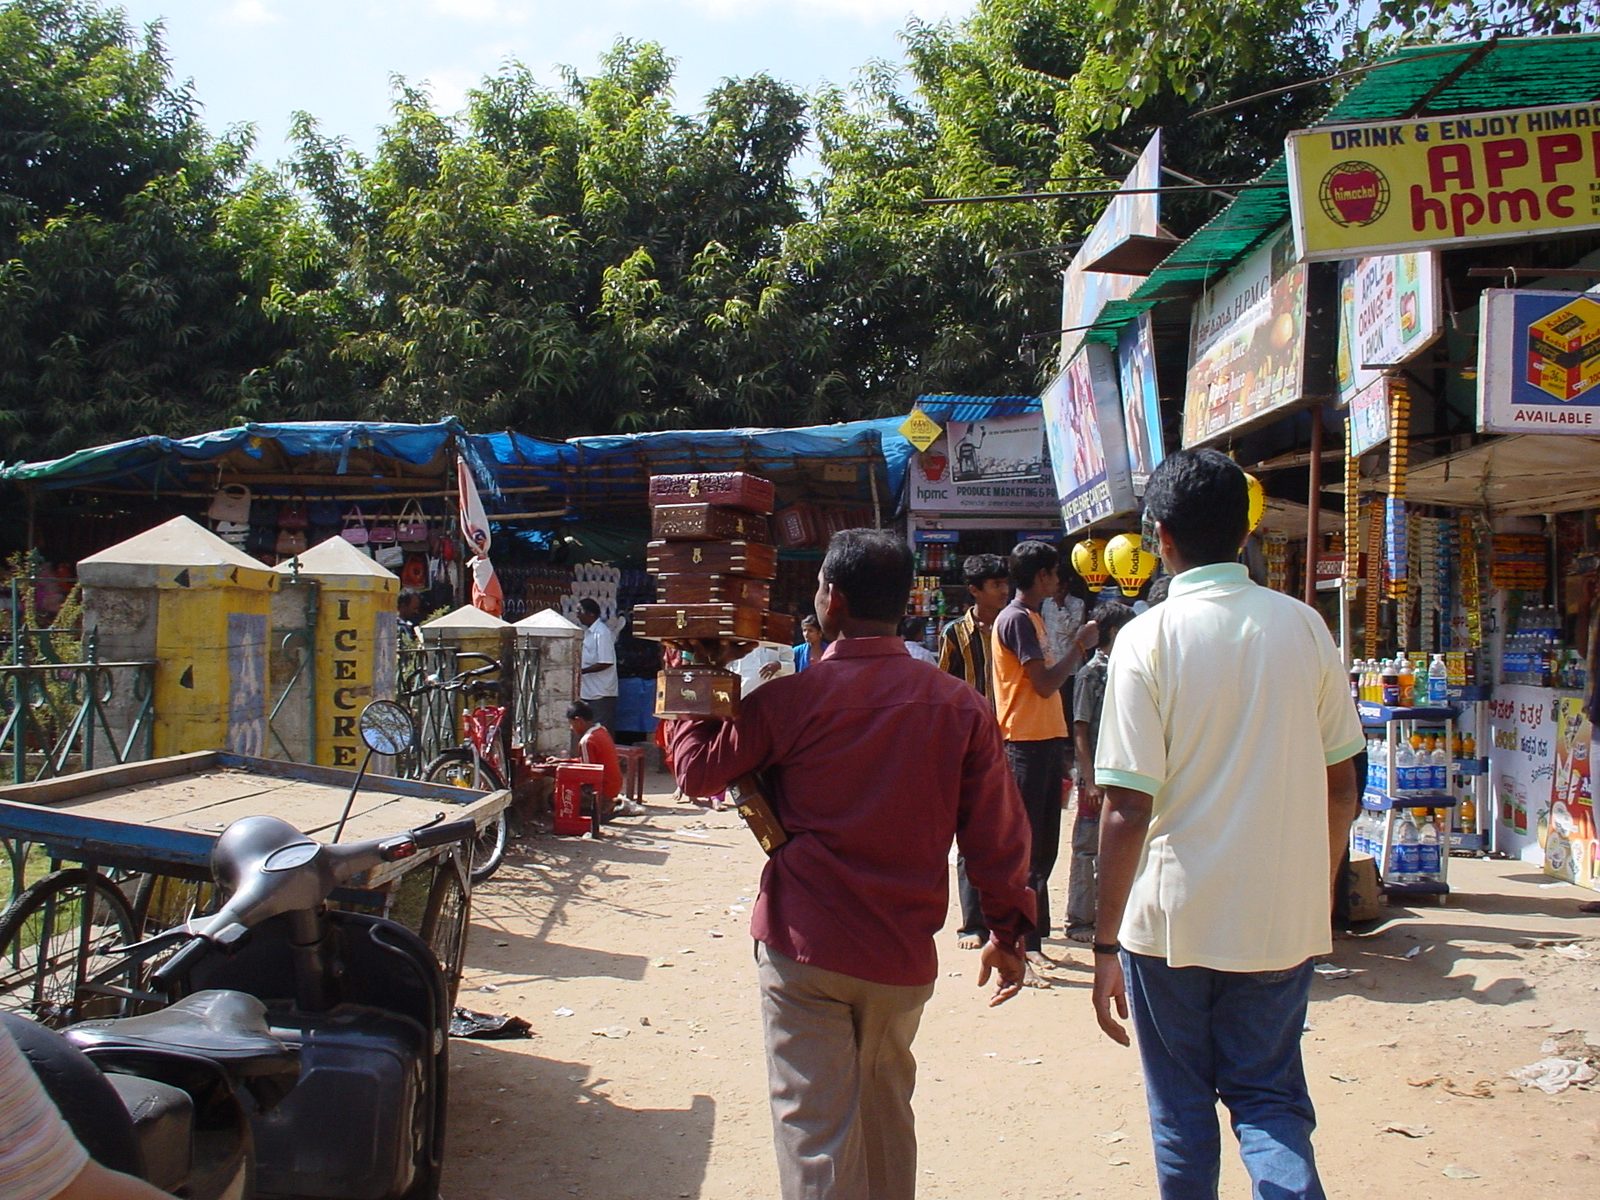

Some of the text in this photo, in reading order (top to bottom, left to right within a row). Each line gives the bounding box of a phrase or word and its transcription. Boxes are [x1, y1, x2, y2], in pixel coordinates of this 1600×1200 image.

[1331, 126, 1405, 150] DRINK
[1415, 124, 1429, 142] &
[1440, 116, 1519, 140] ENJOY
[1334, 183, 1377, 201] himachal
[1410, 184, 1575, 237] hpmc
[1359, 289, 1384, 336] ORANGE
[1362, 323, 1384, 364] LEMON
[1514, 409, 1592, 424] AVAILABLE
[917, 486, 948, 503] hpmc
[956, 486, 991, 497] PRODUCE
[993, 486, 1038, 498] MARKETING
[1129, 547, 1139, 575] Kodak
